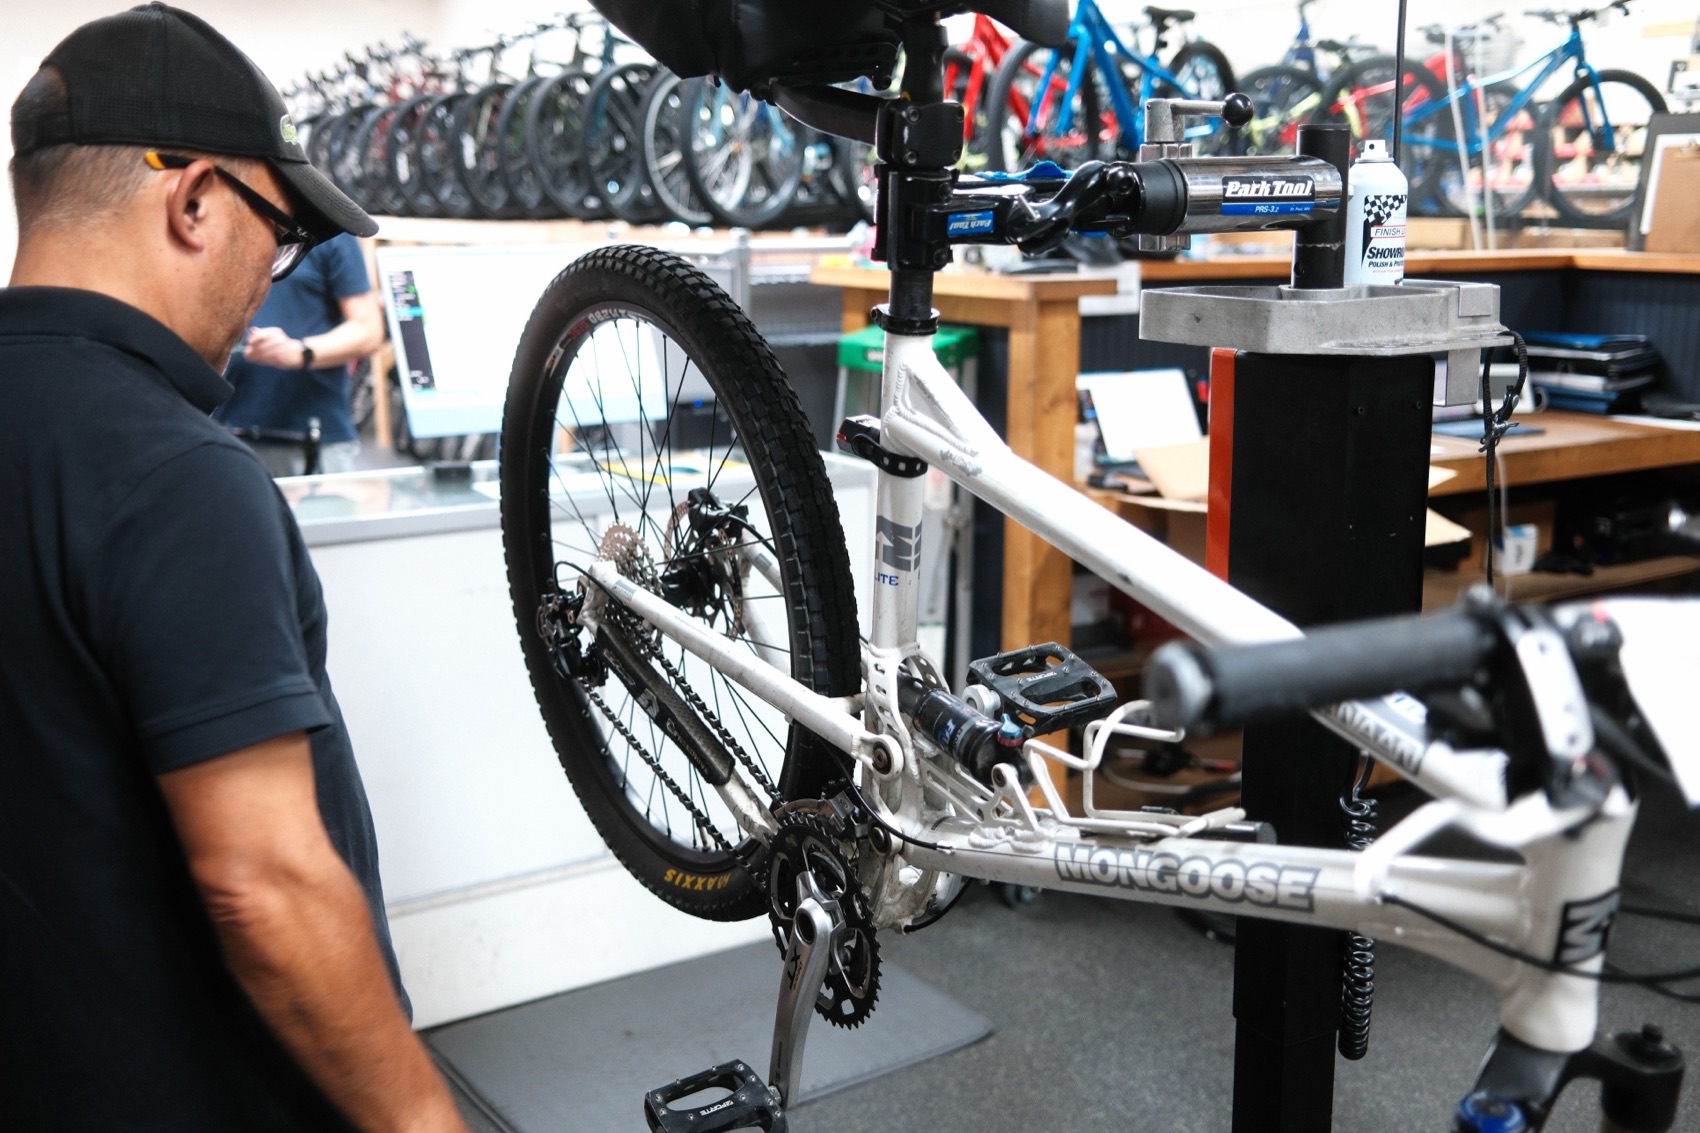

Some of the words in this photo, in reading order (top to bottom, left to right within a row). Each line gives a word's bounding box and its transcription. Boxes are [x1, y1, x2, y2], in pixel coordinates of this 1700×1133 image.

[1225, 180, 1271, 198] Park
[1272, 180, 1313, 196] Tool
[1254, 205, 1280, 213] PRS-3.2
[1374, 228, 1401, 236] FINISH
[1366, 246, 1405, 259] SHOWRO
[1368, 260, 1389, 268] POLISH
[664, 868, 731, 890] MAXXIS
[1055, 842, 1320, 913] MONGOOSE
